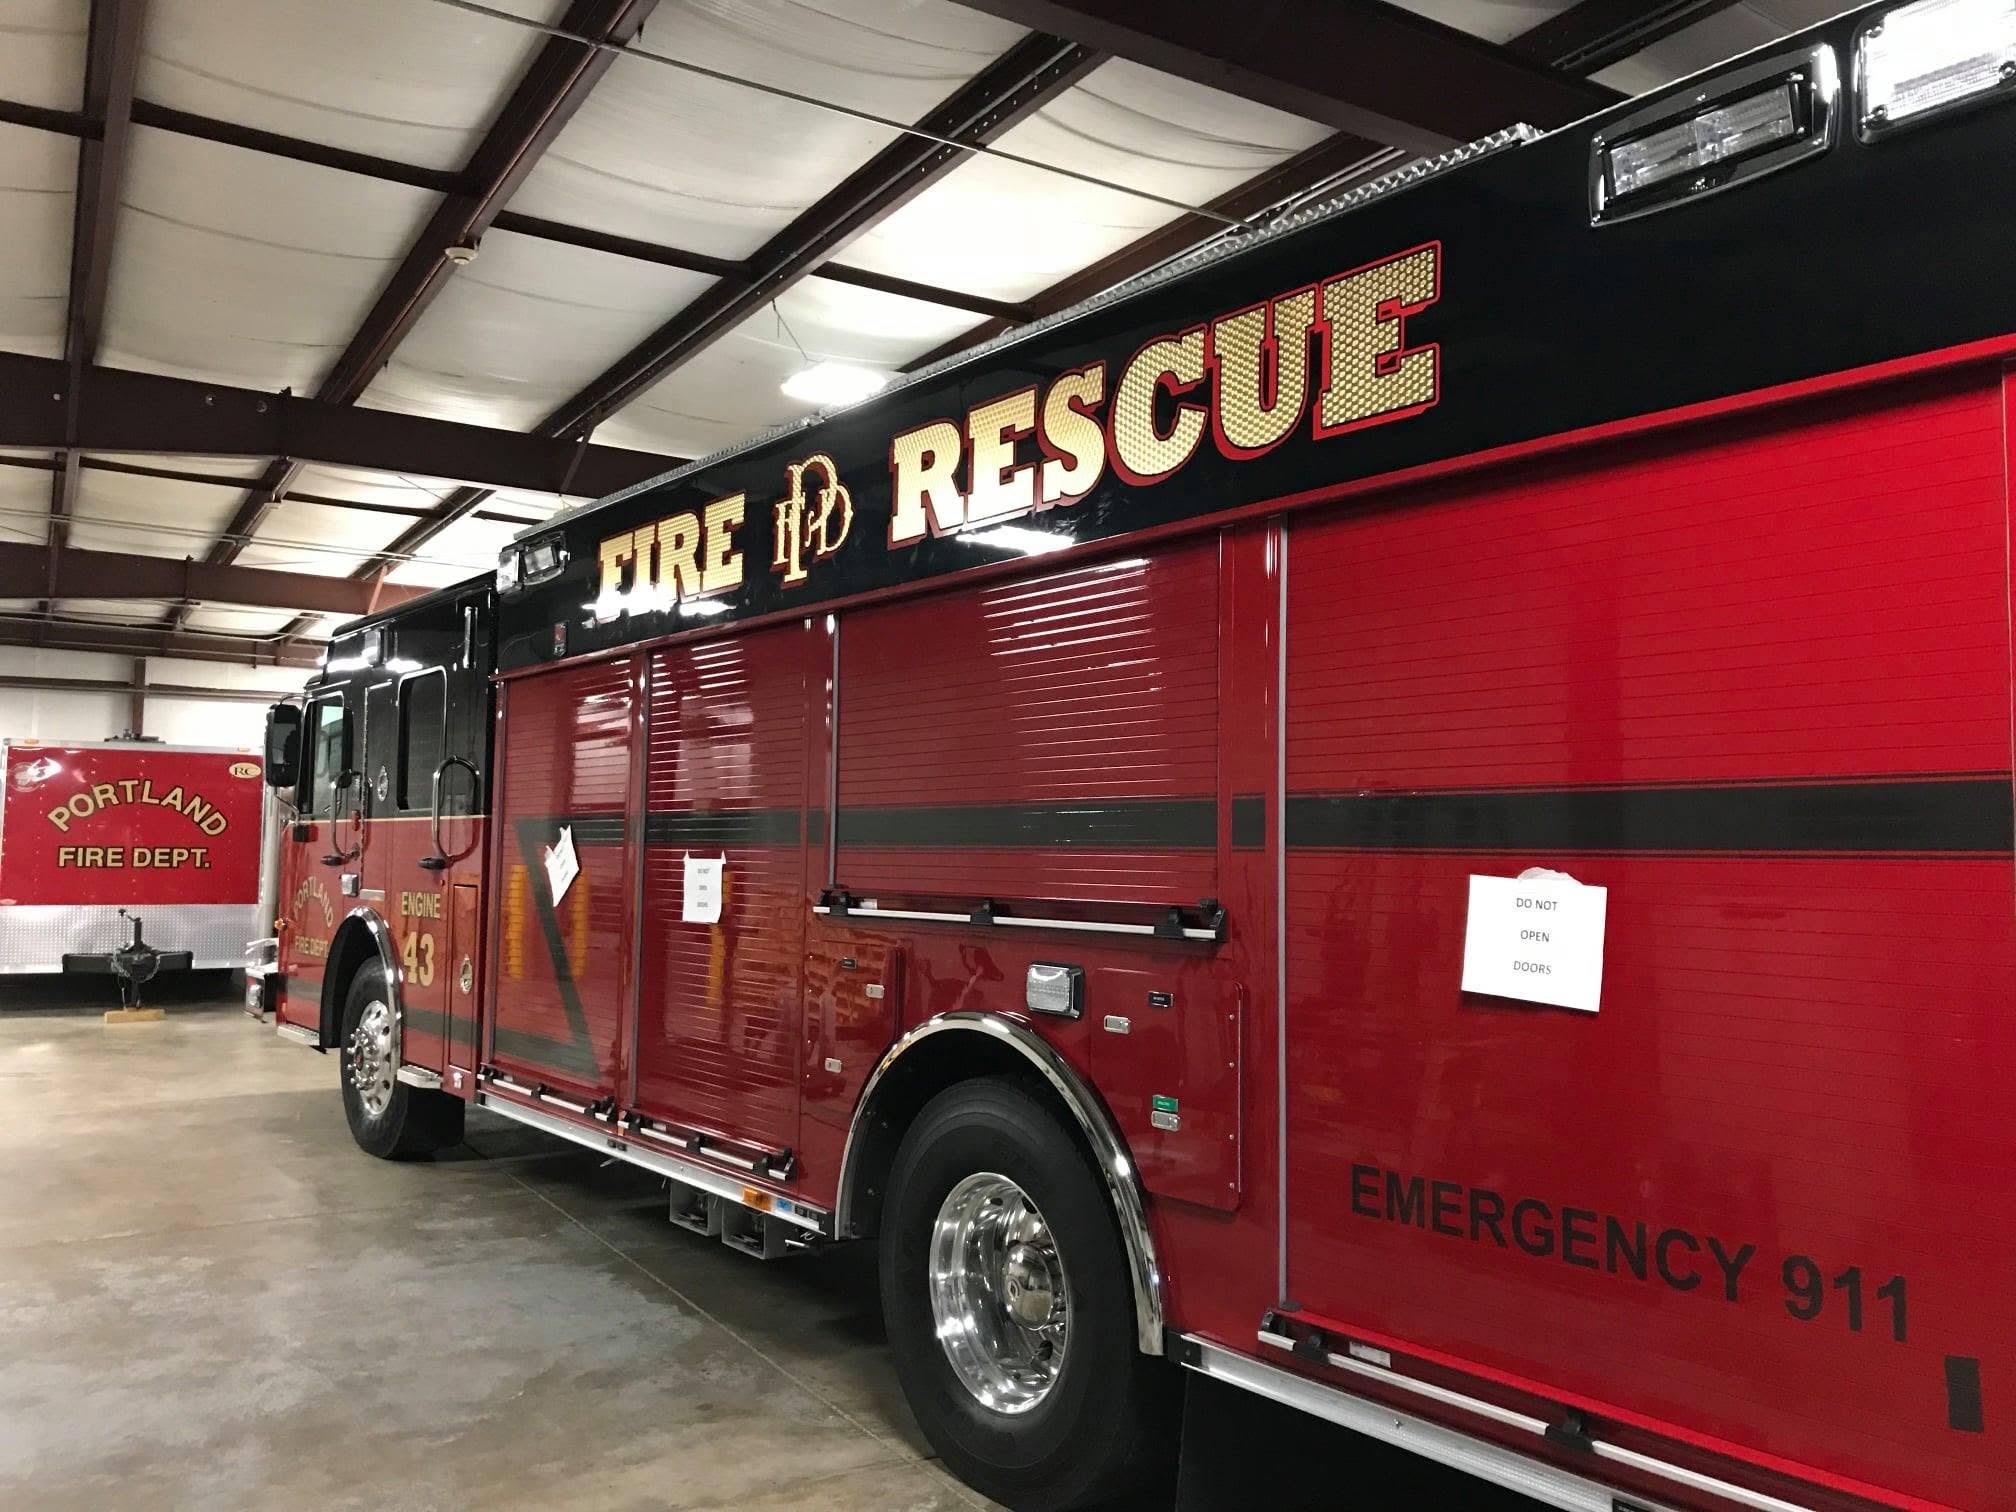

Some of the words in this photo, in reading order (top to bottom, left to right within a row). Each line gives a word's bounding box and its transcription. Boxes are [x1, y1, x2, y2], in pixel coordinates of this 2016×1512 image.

[598, 490, 745, 624] FIRE
[887, 240, 1441, 549] RESCUE
[47, 778, 228, 837] PORTLAND
[58, 847, 124, 868] FIRE
[132, 847, 211, 868] DEPT.
[293, 875, 334, 928] PORTLAND
[401, 892, 441, 919] ENGINE
[1516, 897, 1532, 909] DO
[1535, 899, 1558, 911] NOT
[1520, 930, 1550, 942] OPEN
[402, 931, 435, 987] 43
[1513, 960, 1552, 975] DOORS
[1351, 1164, 1756, 1301] EMERGENCY
[1782, 1256, 1908, 1342] 911
